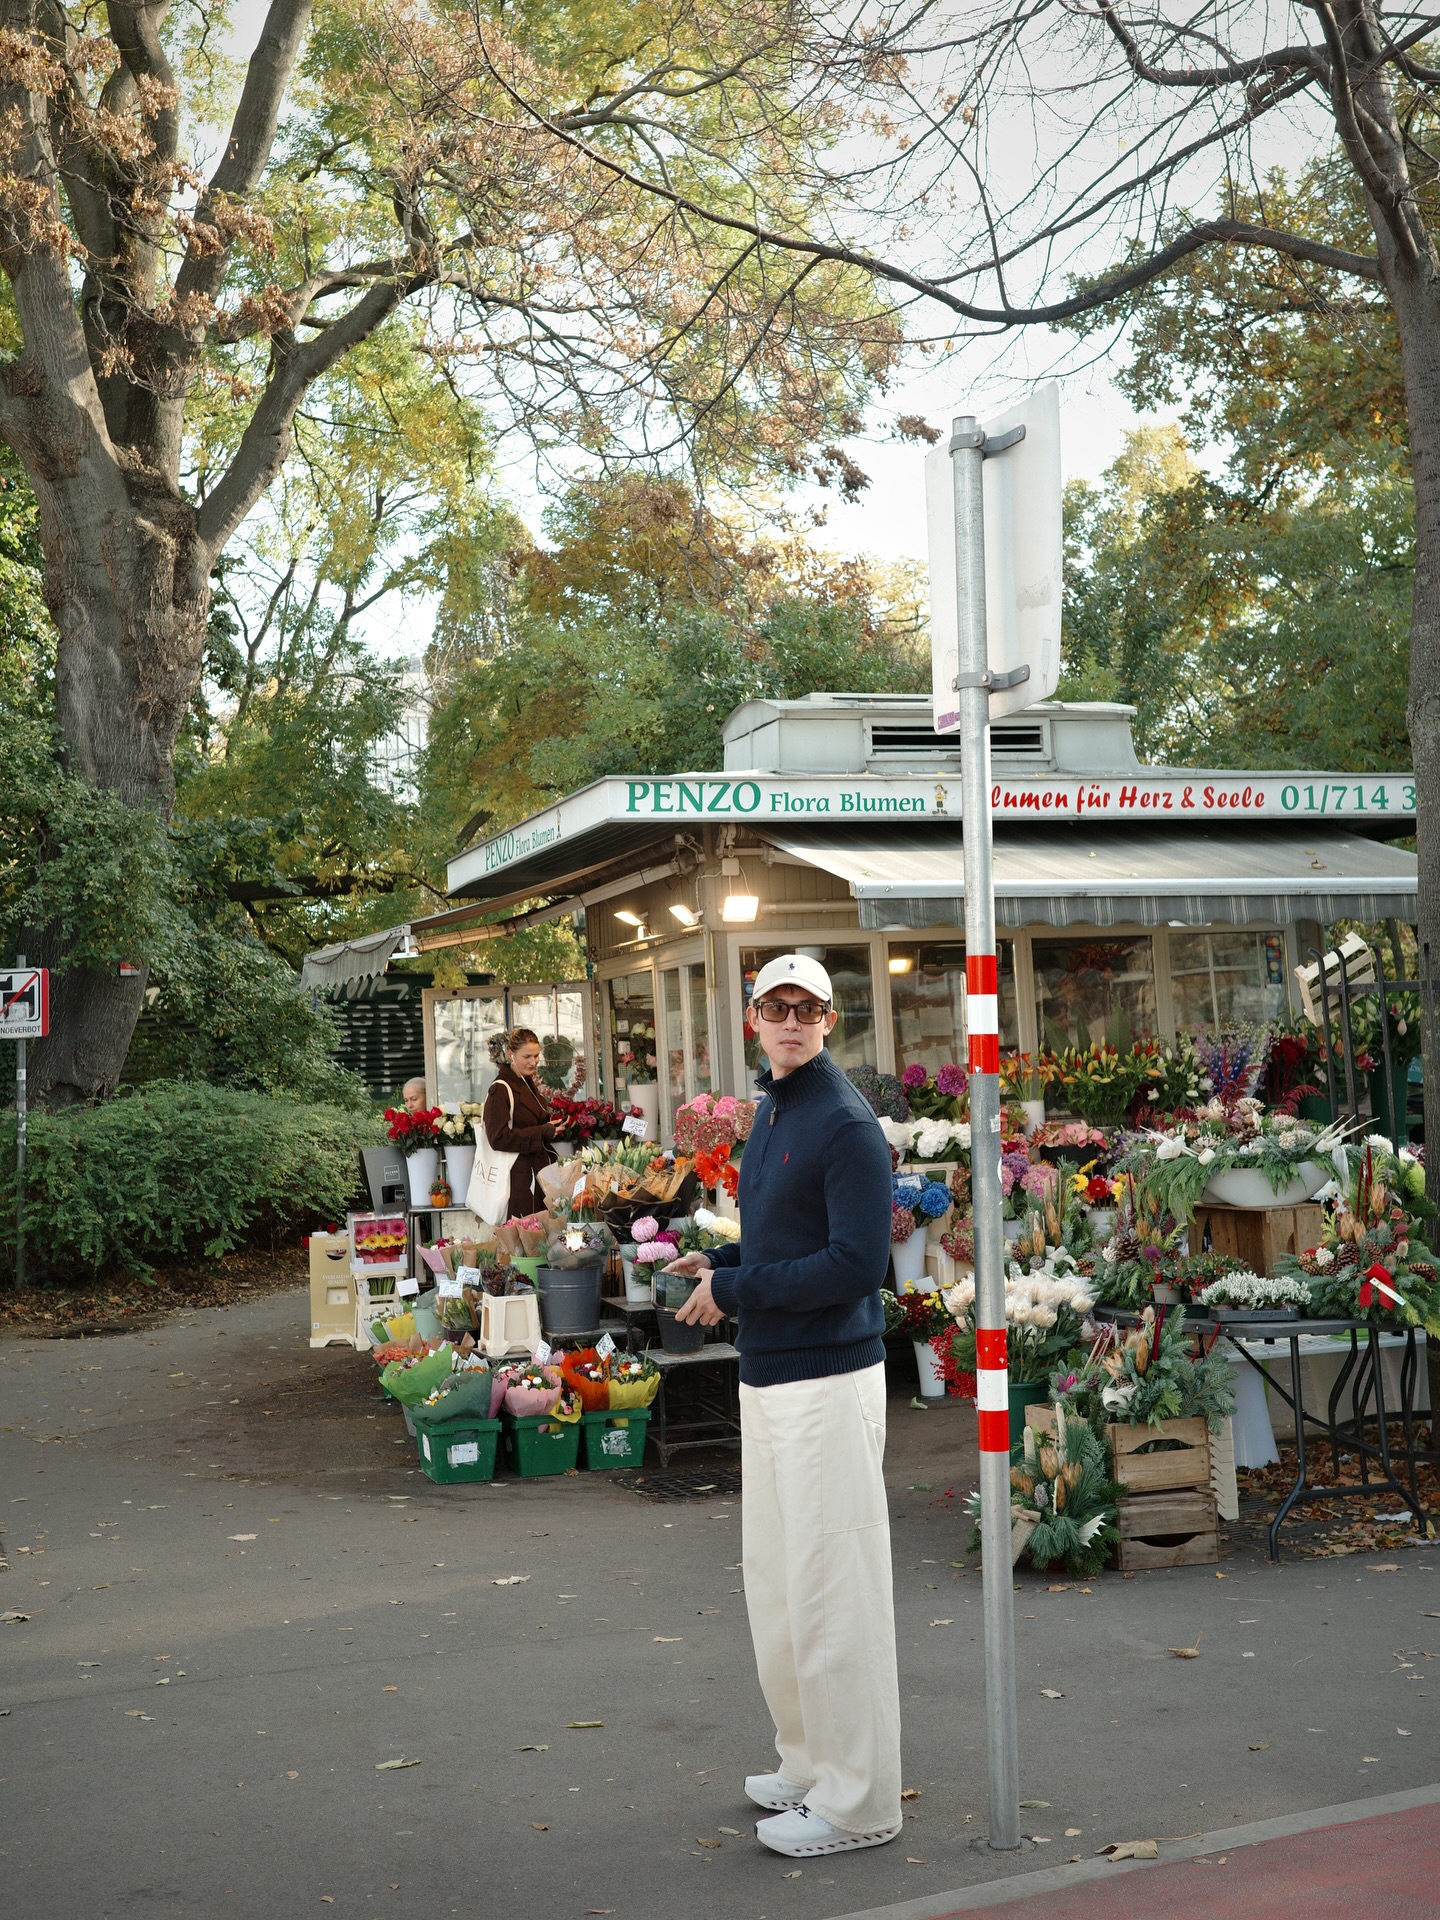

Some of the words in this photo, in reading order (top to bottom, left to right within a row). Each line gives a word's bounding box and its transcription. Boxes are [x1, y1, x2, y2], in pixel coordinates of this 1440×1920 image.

[625, 781, 761, 813] PENZO
[769, 792, 831, 812] Flora
[839, 792, 926, 812] Blumen
[991, 785, 1069, 811] lumen
[1076, 784, 1111, 814] für
[1119, 785, 1173, 810] Herz
[1180, 786, 1196, 809] &
[1203, 785, 1266, 809] Seele
[1280, 785, 1389, 813] 01/714
[1402, 785, 1417, 811] 3
[485, 832, 515, 872] PENZO
[515, 837, 530, 857] Flora
[531, 827, 555, 849] Blumen
[0, 1025, 41, 1034] NDEVERBOT
